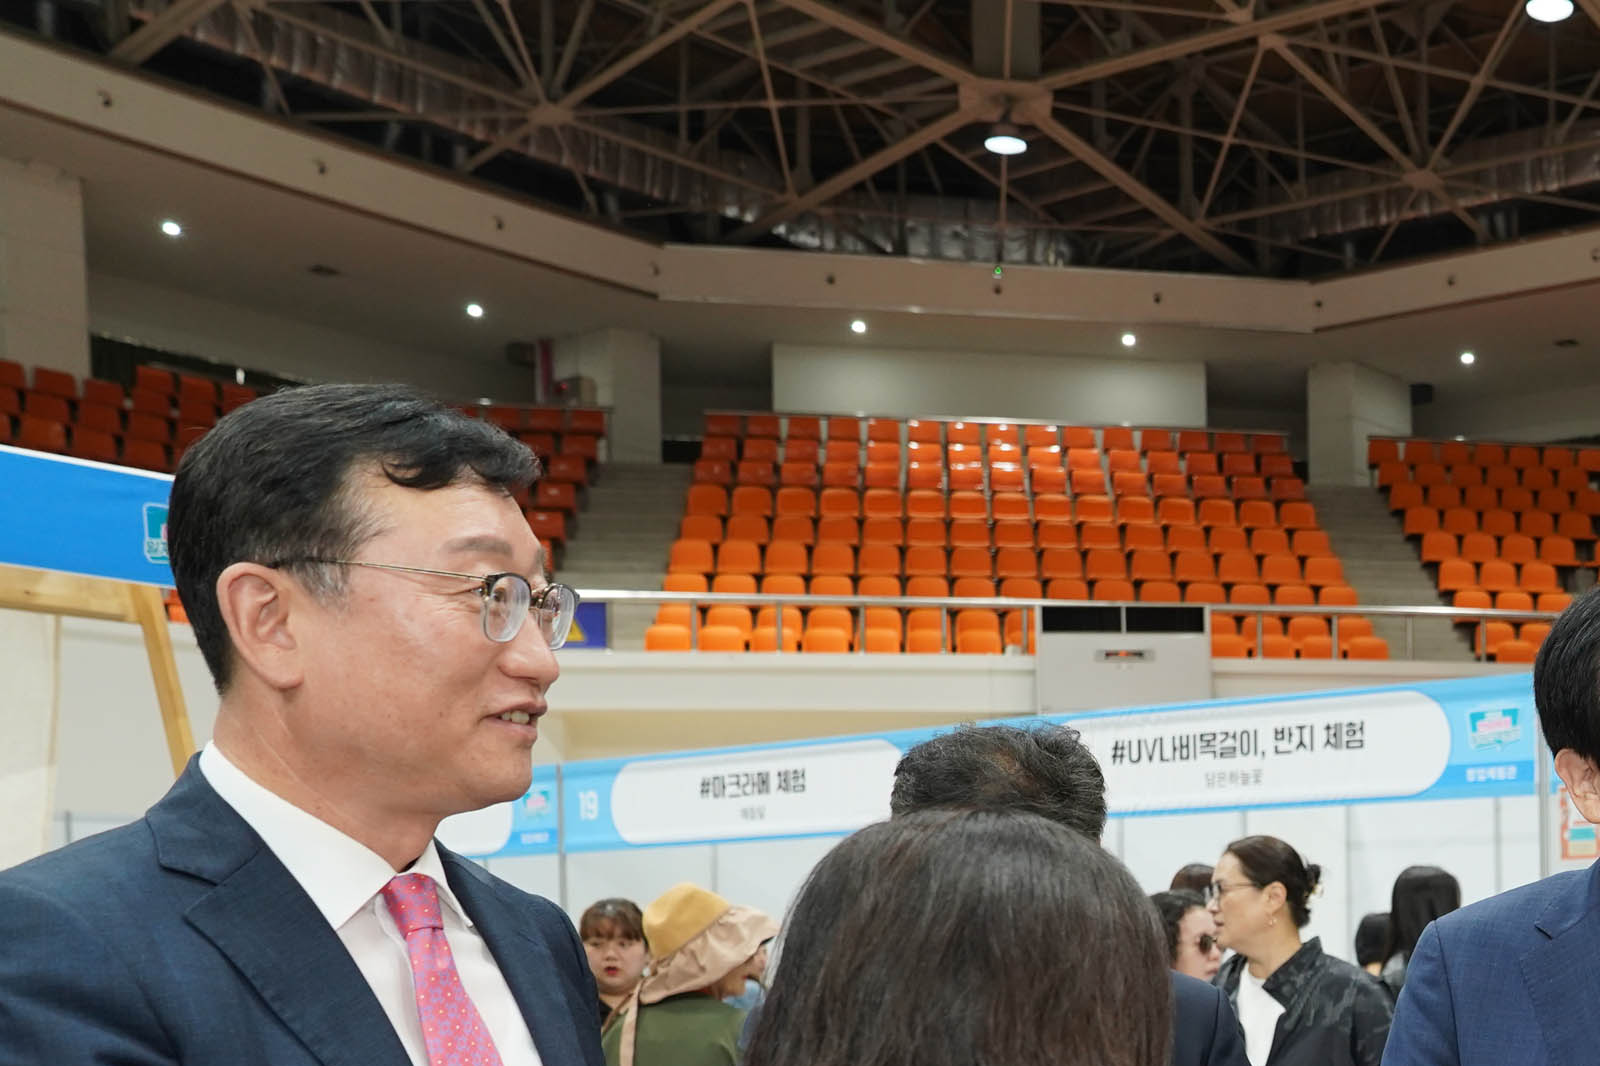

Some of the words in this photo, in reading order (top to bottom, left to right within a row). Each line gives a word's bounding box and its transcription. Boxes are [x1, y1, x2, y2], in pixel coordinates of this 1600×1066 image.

[1111, 729, 1267, 765] #UV나비목걸이,
[1273, 724, 1315, 755] 반지
[1324, 720, 1365, 750] 체험
[700, 771, 771, 799] #마크라메
[776, 768, 807, 792] 체험
[579, 790, 599, 820] 19
